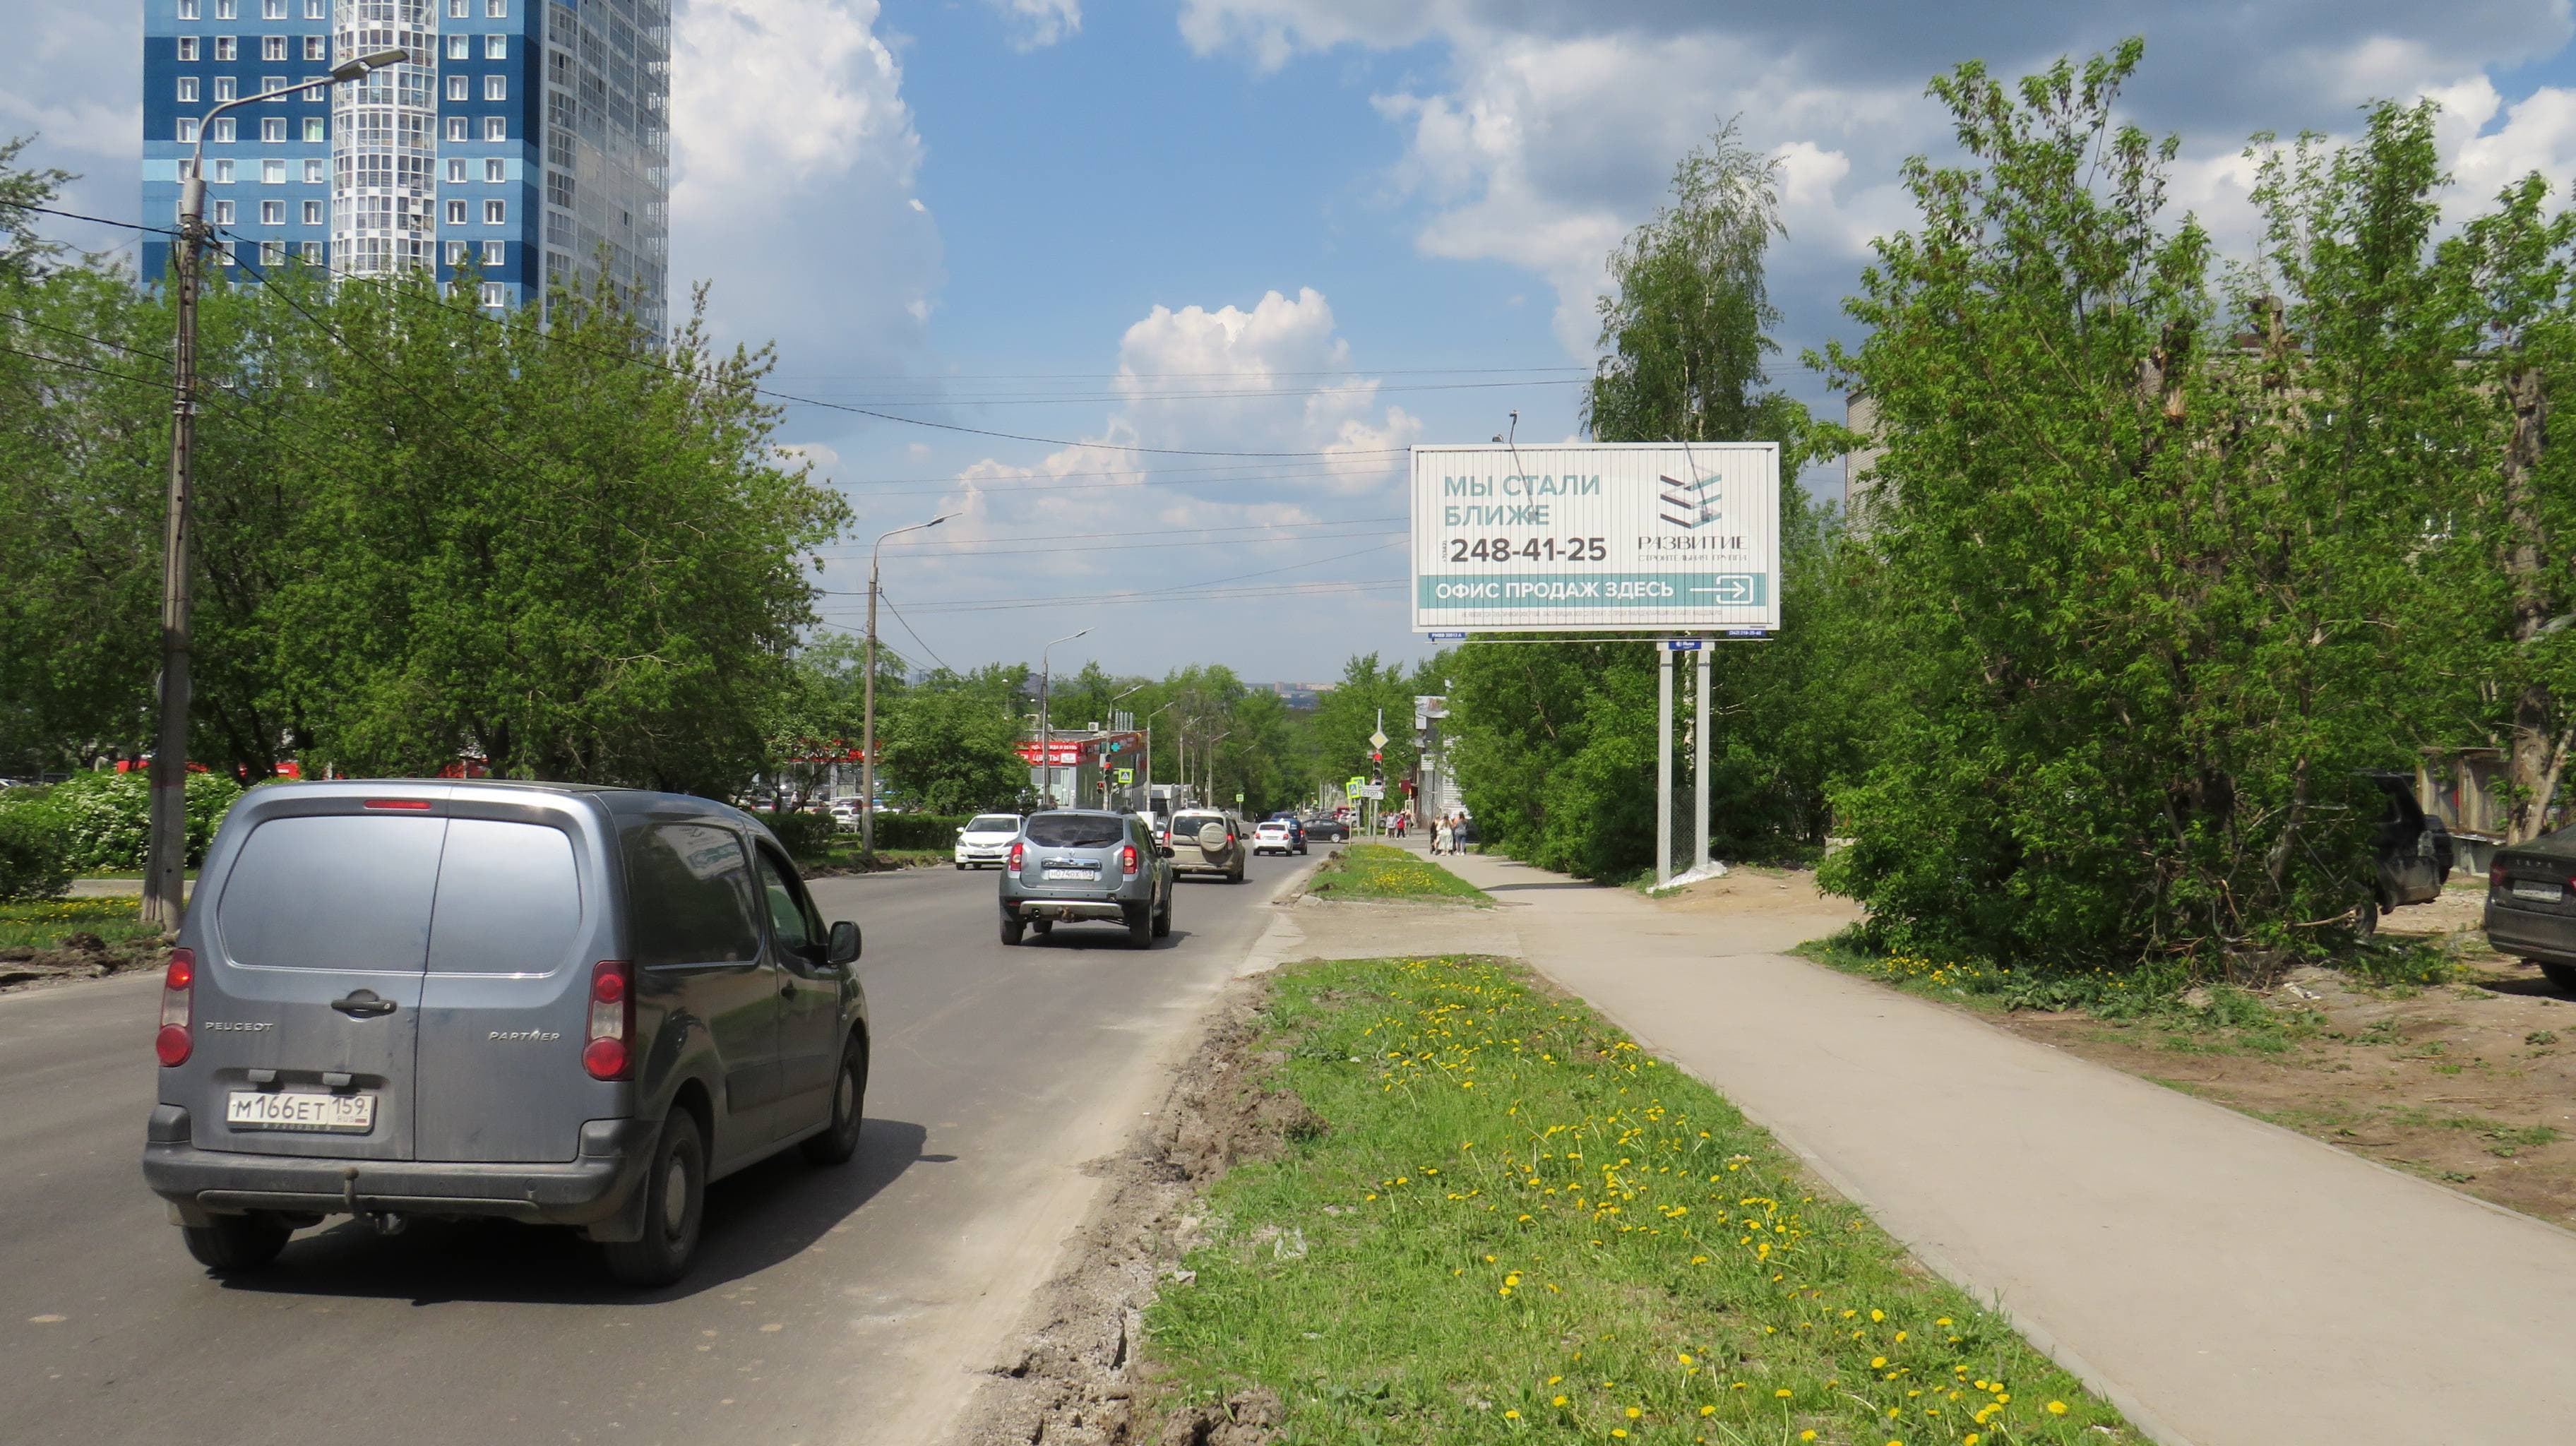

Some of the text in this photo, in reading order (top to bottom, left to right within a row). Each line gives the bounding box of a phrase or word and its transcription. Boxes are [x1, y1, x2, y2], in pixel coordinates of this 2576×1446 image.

[1444, 474, 1601, 496] МЫ СТАЛИ
[1444, 504, 1551, 526] БЛИЖЕ
[1450, 537, 1606, 562] 248-41-25
[1638, 536, 1748, 550] РАЗВИТИЕ
[1435, 580, 1674, 600] ОФИС ПРОДАЖ ЗДЕСЬ
[205, 1021, 275, 1032] PEUGEOT
[488, 1028, 561, 1042] PARTNER
[235, 1095, 366, 1121] М166ЕТ 159
